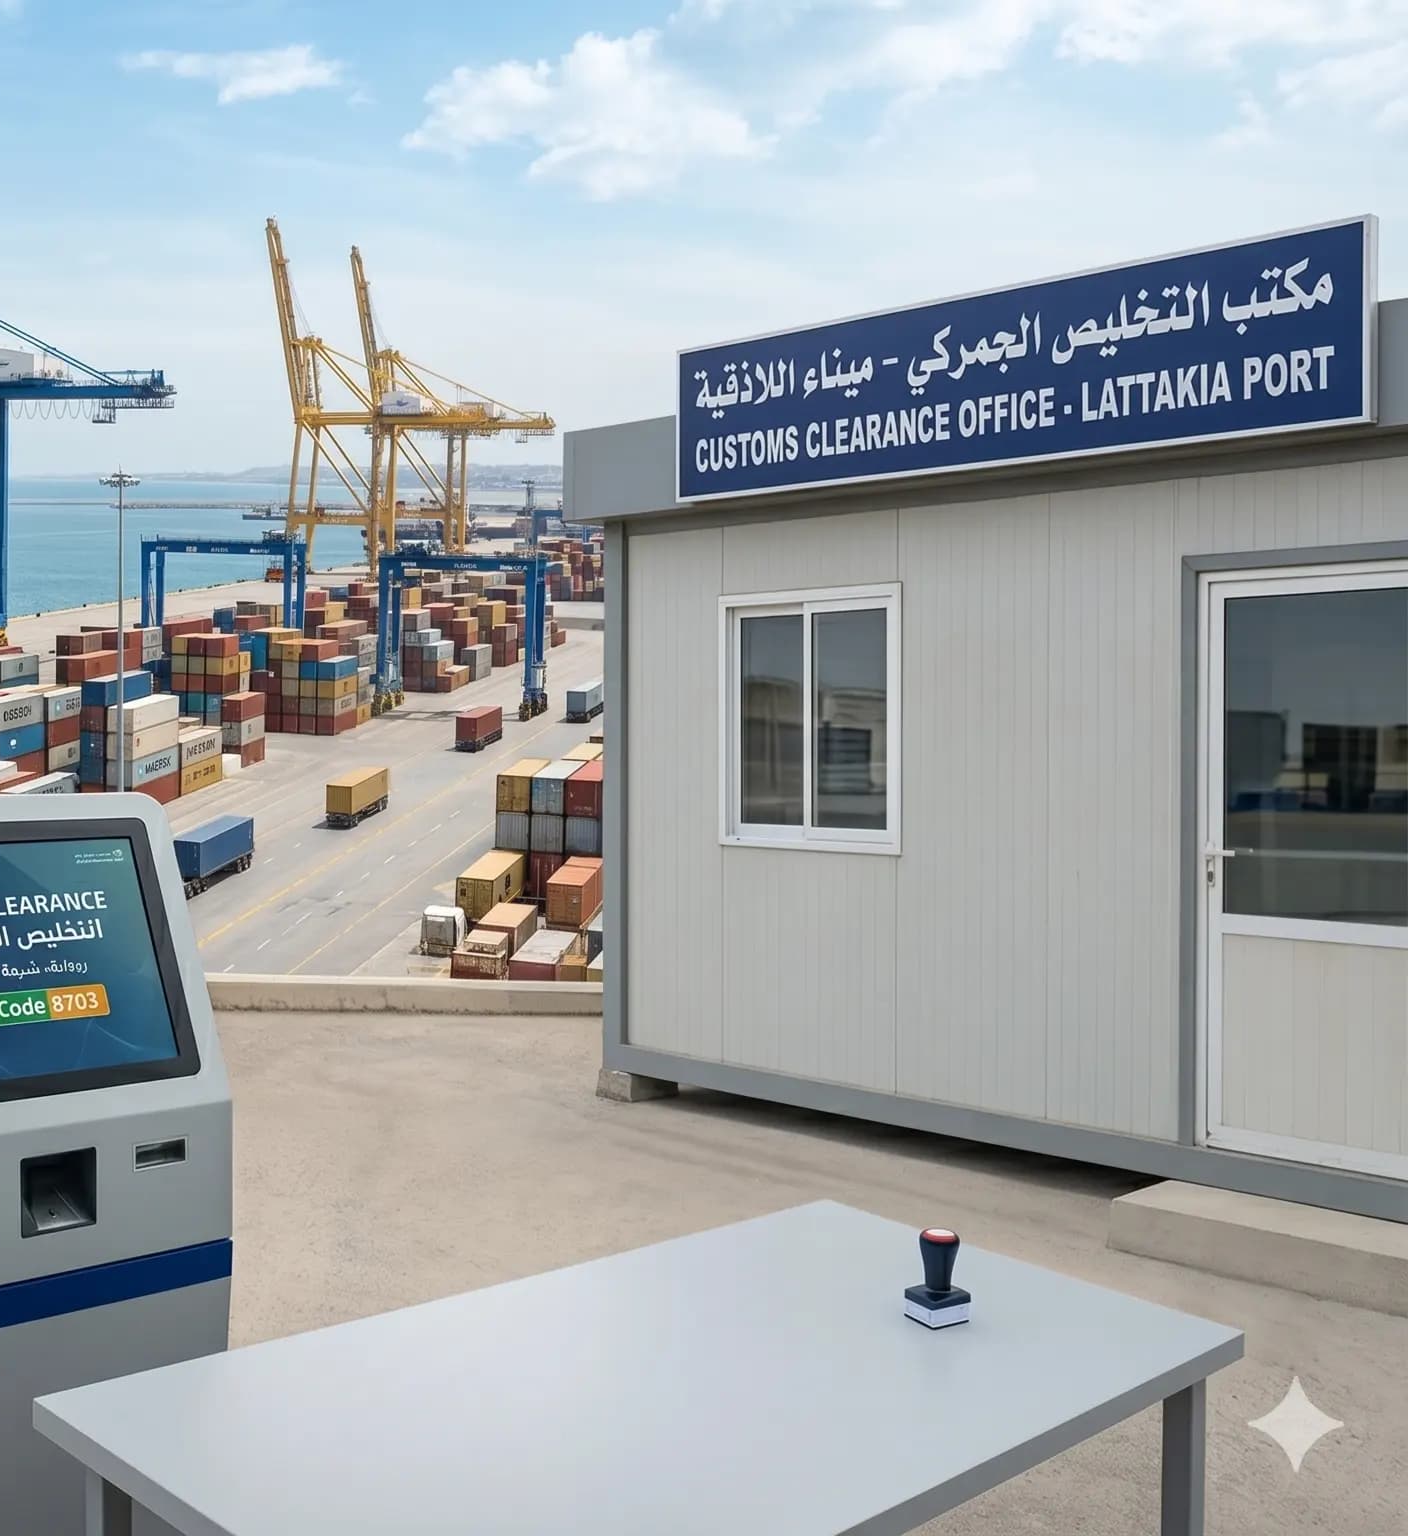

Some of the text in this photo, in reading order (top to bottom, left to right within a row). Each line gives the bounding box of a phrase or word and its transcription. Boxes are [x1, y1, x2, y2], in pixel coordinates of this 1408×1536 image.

[1051, 280, 1210, 365] التخليص
[1222, 257, 1334, 335] مكتب
[693, 358, 795, 420] اللاذقية
[803, 347, 874, 398] ميناء
[907, 312, 1041, 396] الجمركي
[695, 425, 799, 473] CUSTOMS
[805, 403, 951, 458] CLEARANCE
[958, 387, 1055, 438] OFFICE
[1082, 361, 1232, 422] LATTAKIA
[1243, 345, 1335, 400] PORT
[51, 991, 99, 1013] 8703
